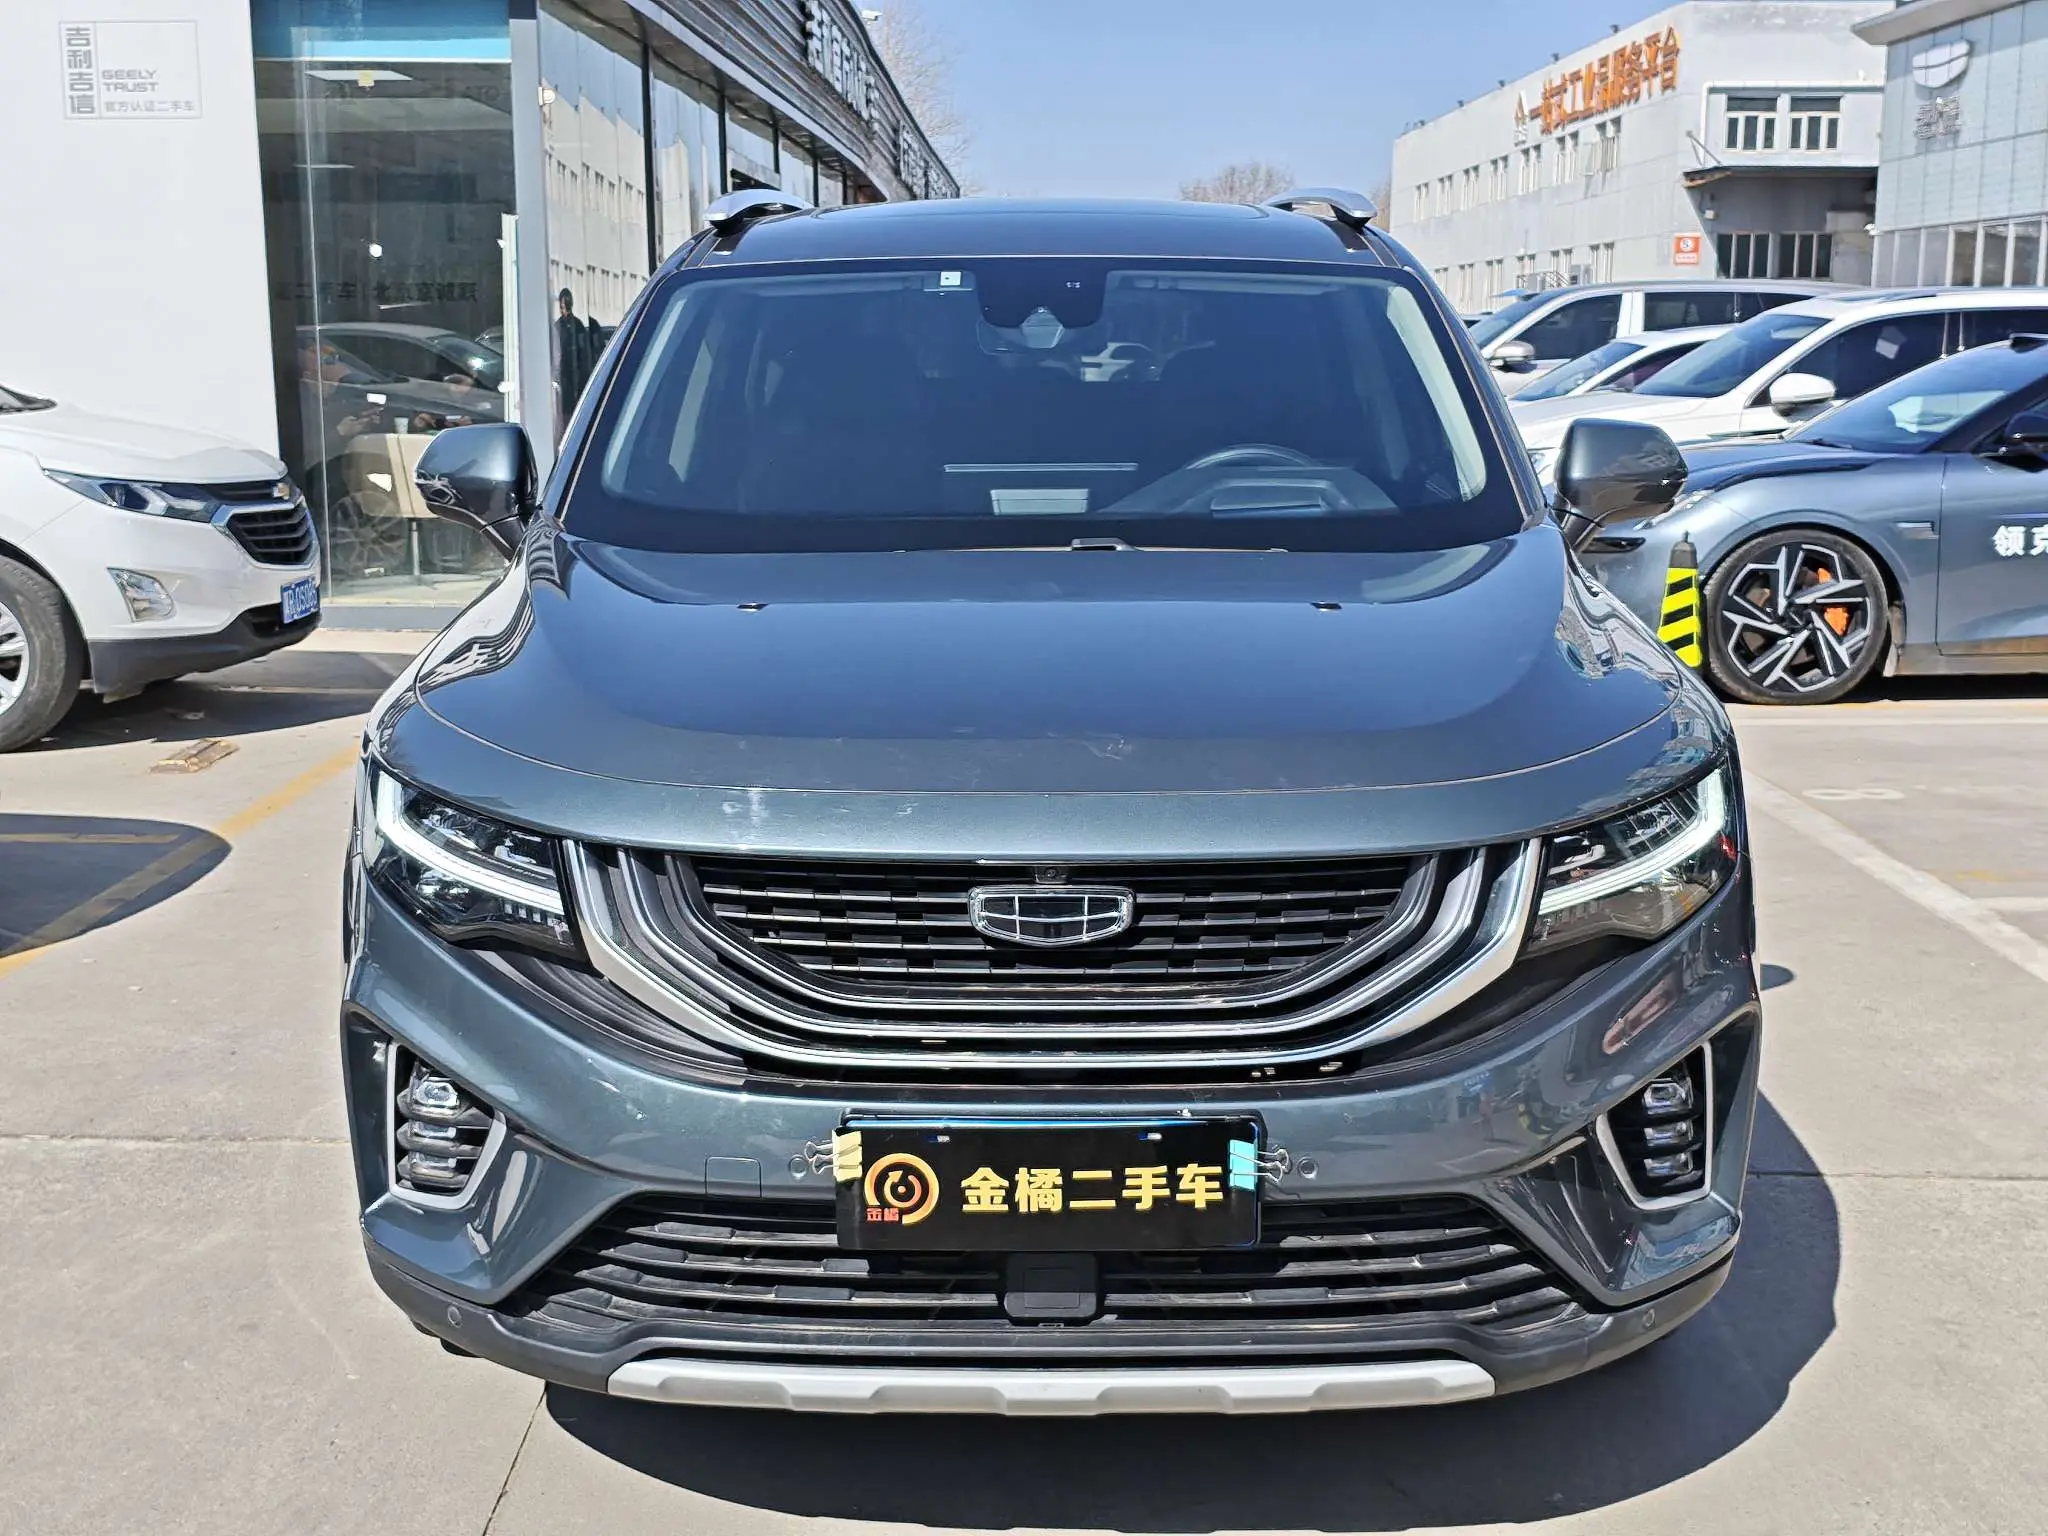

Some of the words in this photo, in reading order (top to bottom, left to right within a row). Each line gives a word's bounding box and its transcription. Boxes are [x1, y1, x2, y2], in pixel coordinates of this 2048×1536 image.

[66, 26, 96, 115] 吉利吉信
[101, 70, 157, 80] GEELY
[104, 82, 158, 92] TRUST
[961, 1165, 1224, 1214] 金橘二手车
